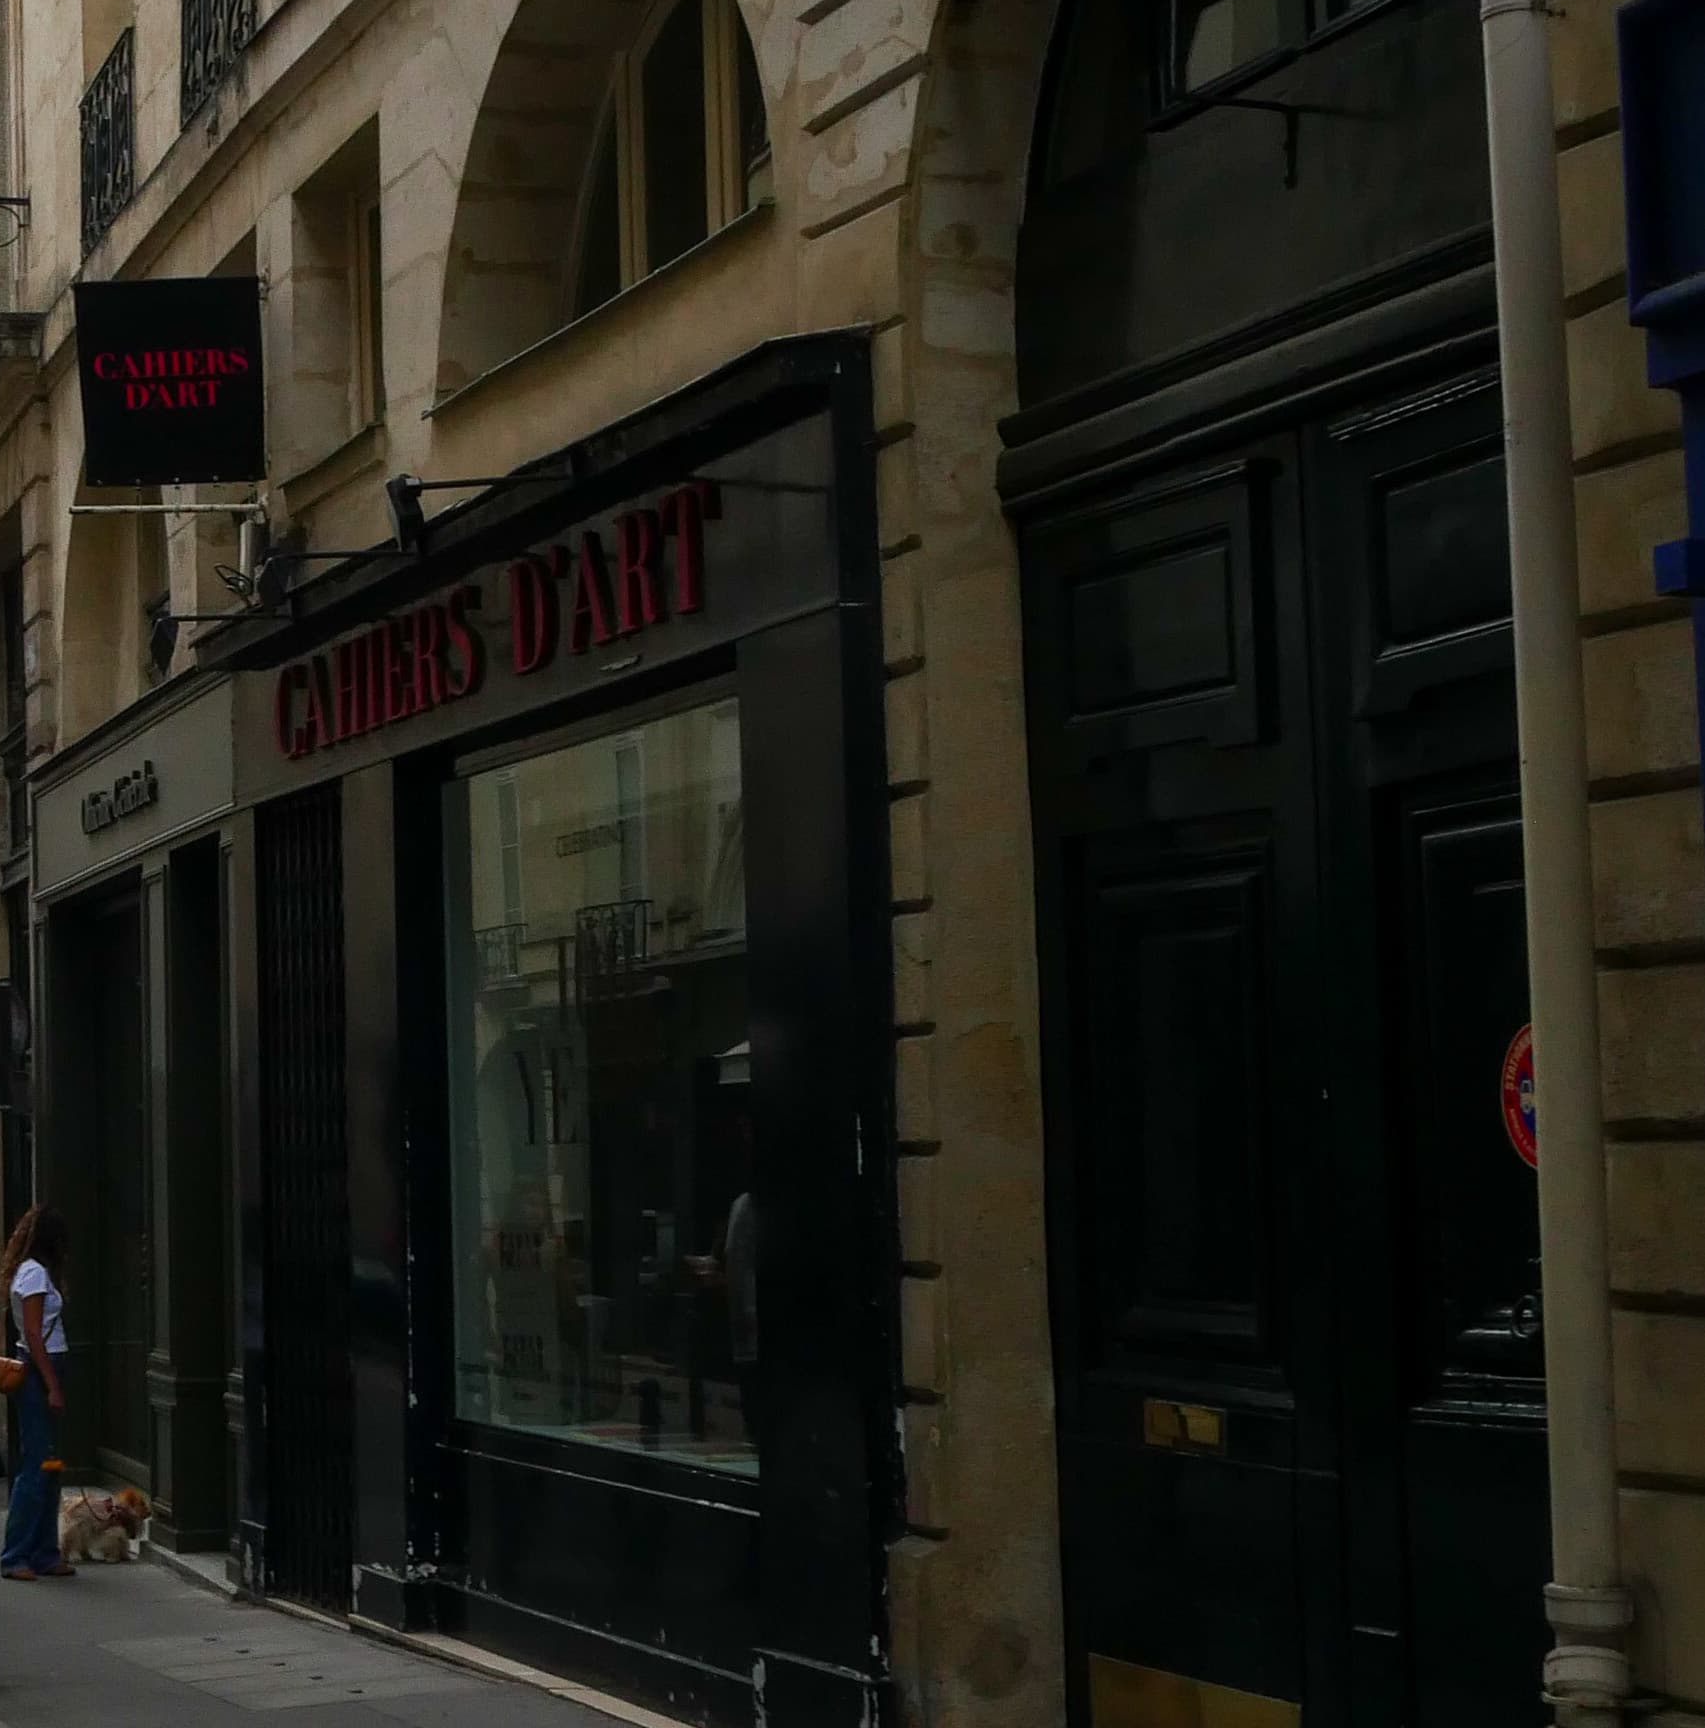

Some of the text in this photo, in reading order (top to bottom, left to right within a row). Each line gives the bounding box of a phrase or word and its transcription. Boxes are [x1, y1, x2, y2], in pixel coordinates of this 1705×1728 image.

[92, 347, 248, 379] CAHIERS
[124, 379, 223, 410] D'ART
[273, 480, 722, 759] CAHIERS D'ART
